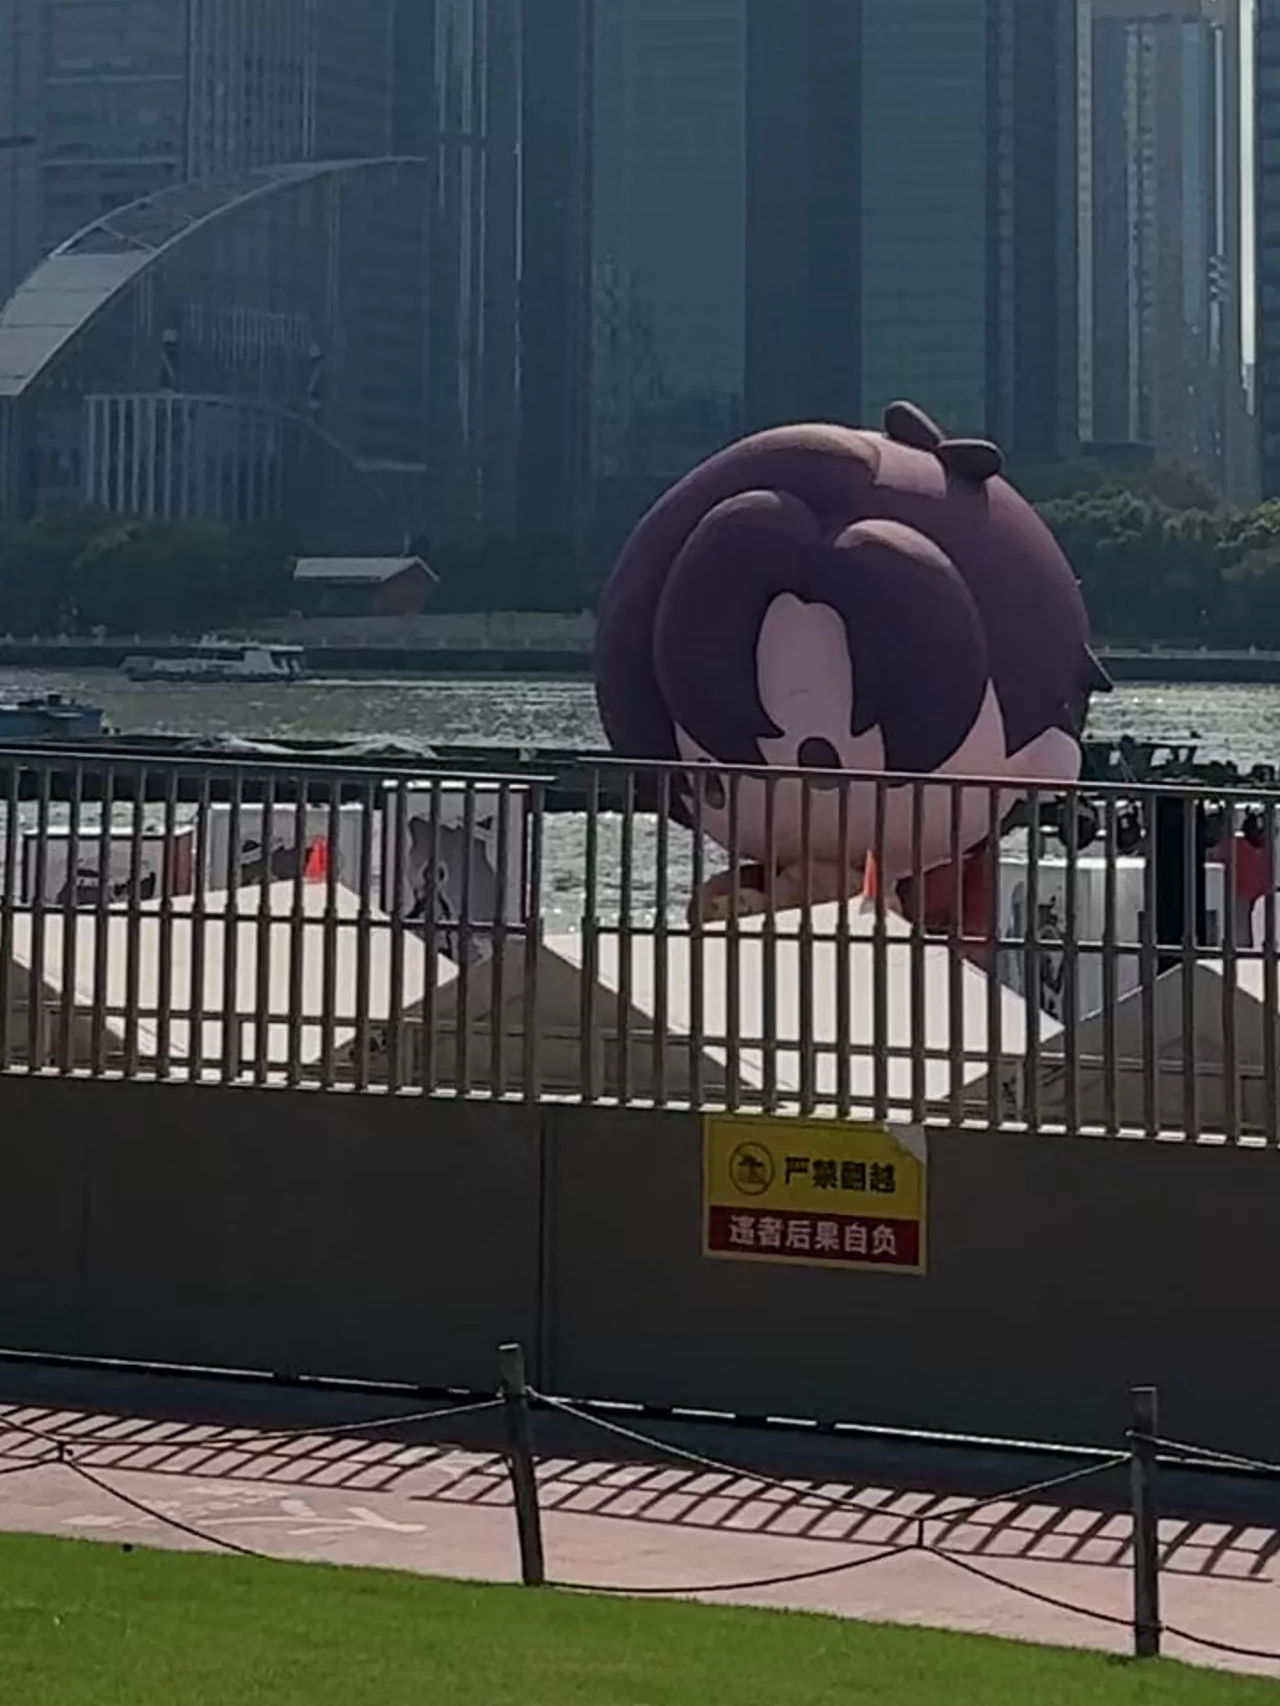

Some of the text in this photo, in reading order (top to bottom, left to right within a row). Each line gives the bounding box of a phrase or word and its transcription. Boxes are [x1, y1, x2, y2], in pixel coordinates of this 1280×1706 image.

[784, 1156, 897, 1194] 严禁翻越
[728, 1214, 897, 1256] 违者后果自负
